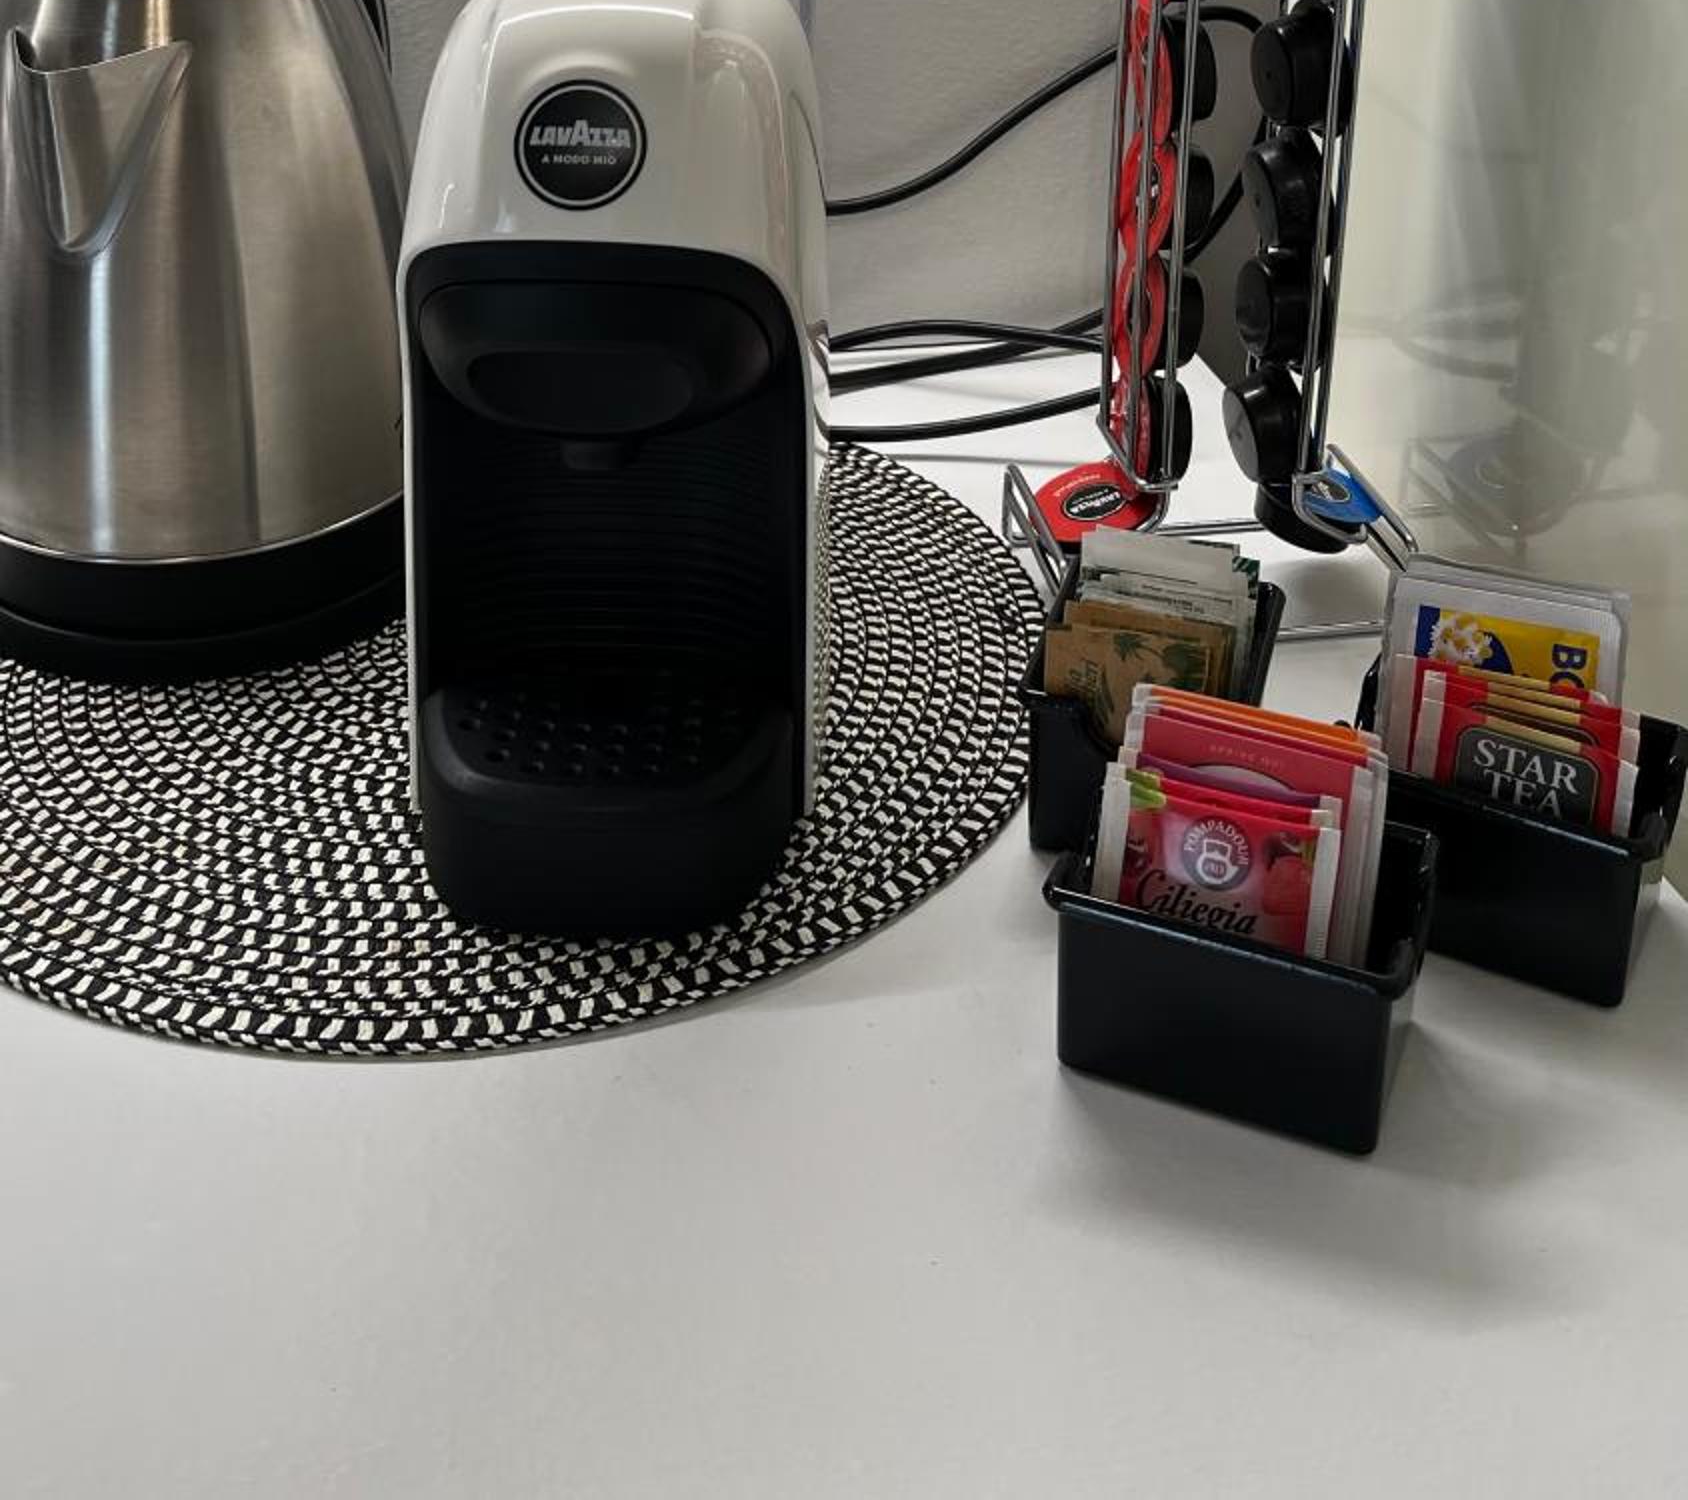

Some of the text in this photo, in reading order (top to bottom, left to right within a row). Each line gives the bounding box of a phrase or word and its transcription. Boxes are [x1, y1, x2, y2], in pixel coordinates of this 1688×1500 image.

[529, 119, 632, 149] LAVAZZA
[541, 154, 618, 166] A MODO MIO
[1473, 739, 1579, 795] STAR
[1483, 768, 1563, 819] TEA
[1183, 819, 1249, 866] POMPADOUR
[1136, 869, 1258, 934] Ciliegia
